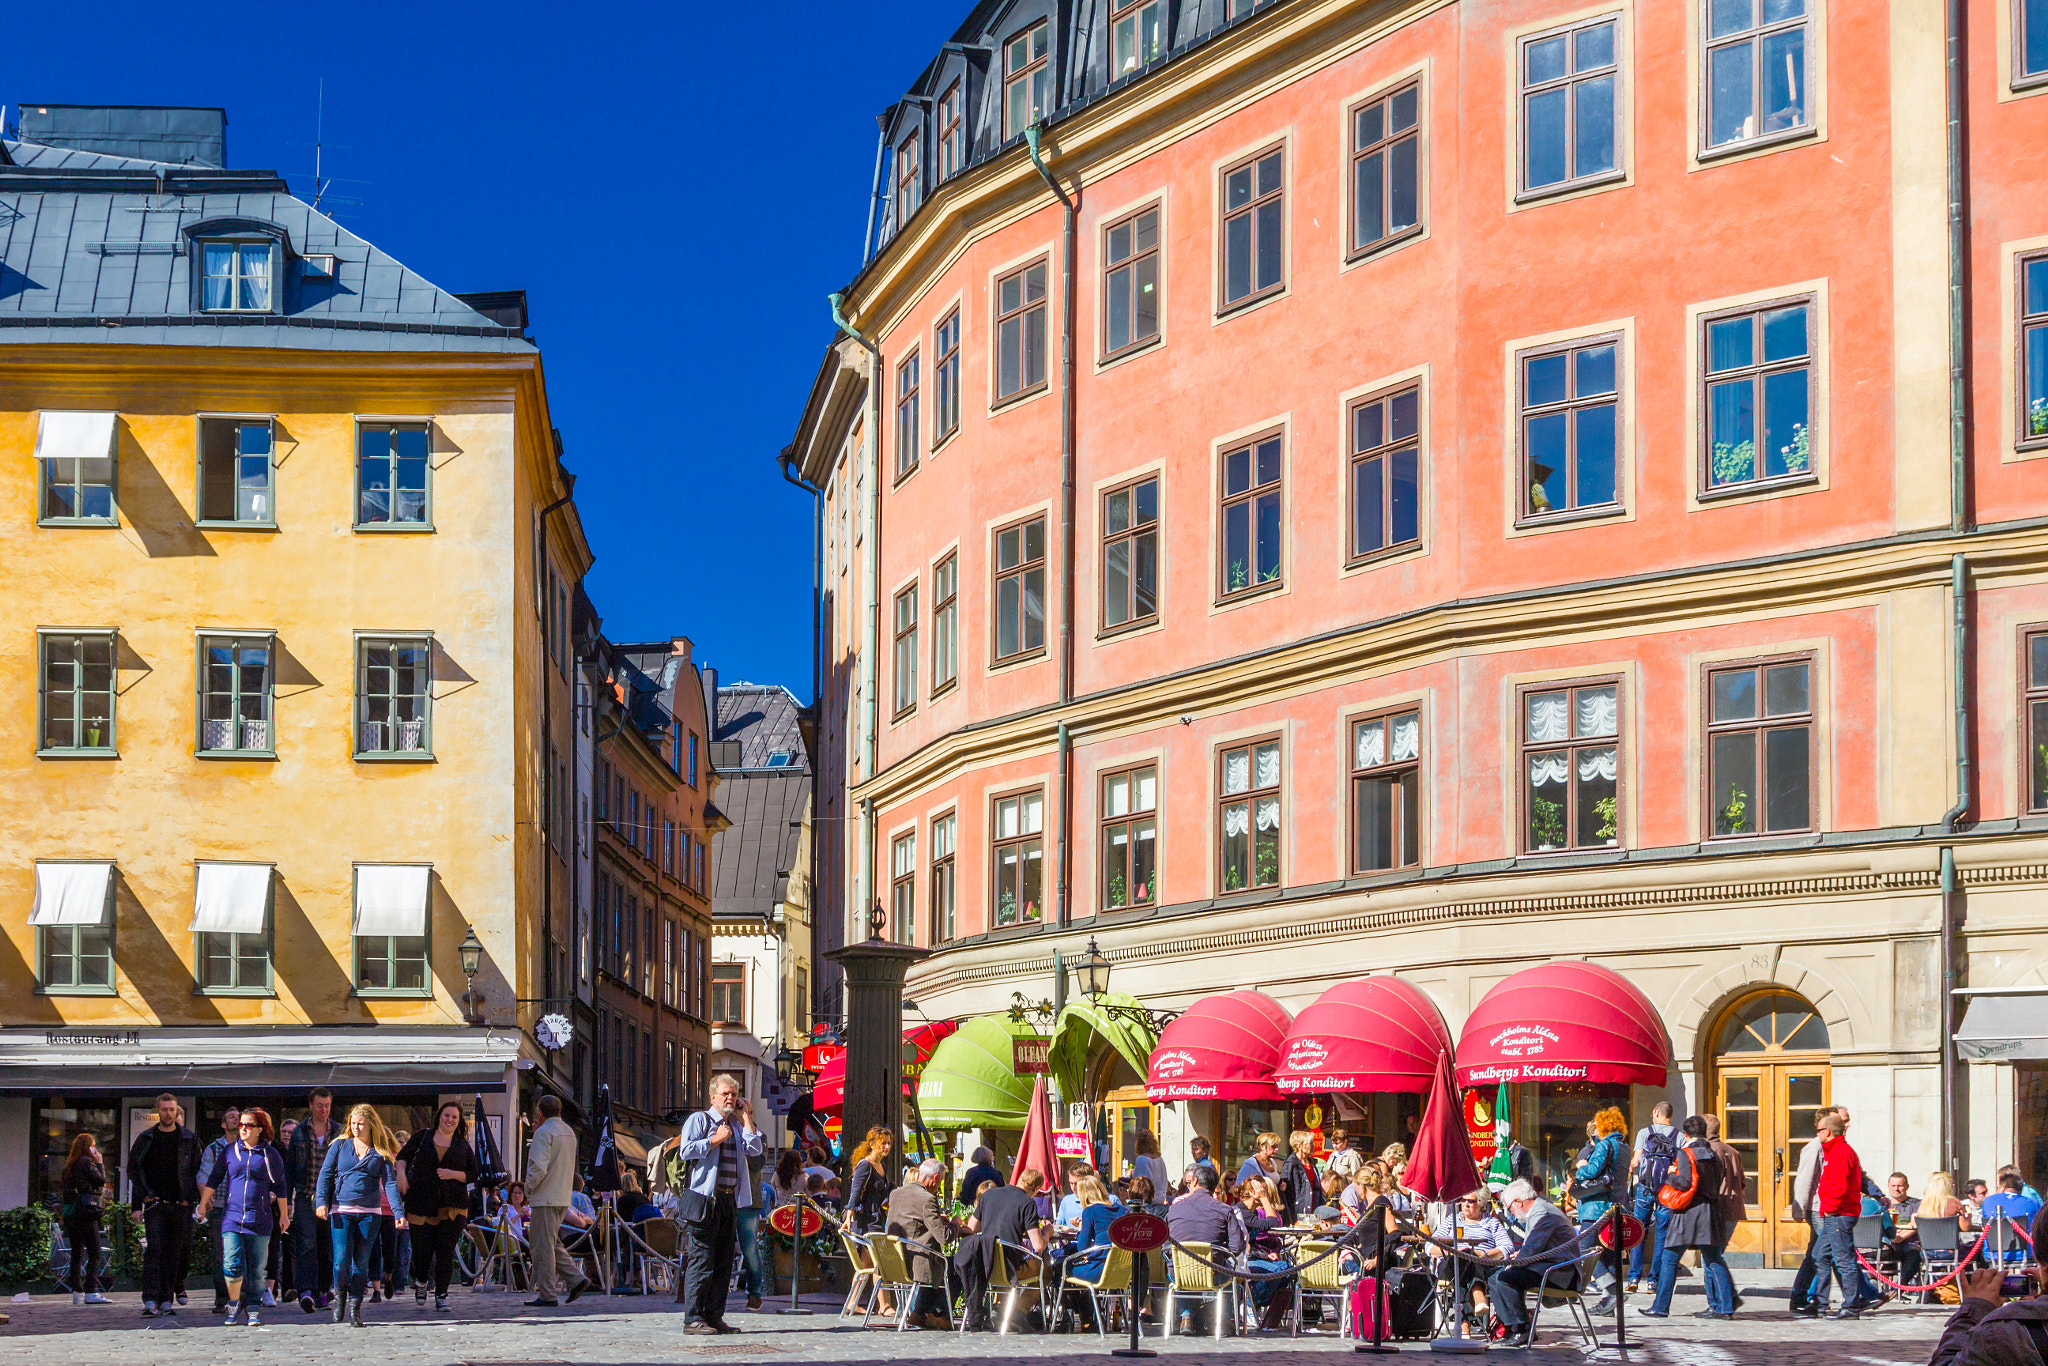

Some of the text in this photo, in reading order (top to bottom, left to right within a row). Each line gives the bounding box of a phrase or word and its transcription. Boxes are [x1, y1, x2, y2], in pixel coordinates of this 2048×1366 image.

[1751, 955, 1769, 968] 83
[46, 1032, 119, 1046] Restaurang
[548, 1031, 559, 1042] JT
[1490, 1025, 1559, 1047] Stockholms Äldsta
[1502, 1036, 1544, 1046] Konditori
[1018, 1046, 1049, 1063] OLEAN
[1526, 1044, 1544, 1055] 1785
[1978, 1041, 2022, 1058] Spendrups
[1469, 1064, 1587, 1081] Sundbergs Konditori
[1302, 1076, 1355, 1089] Konditori
[1168, 1084, 1217, 1096] Konditori
[1073, 1104, 1084, 1116] 83
